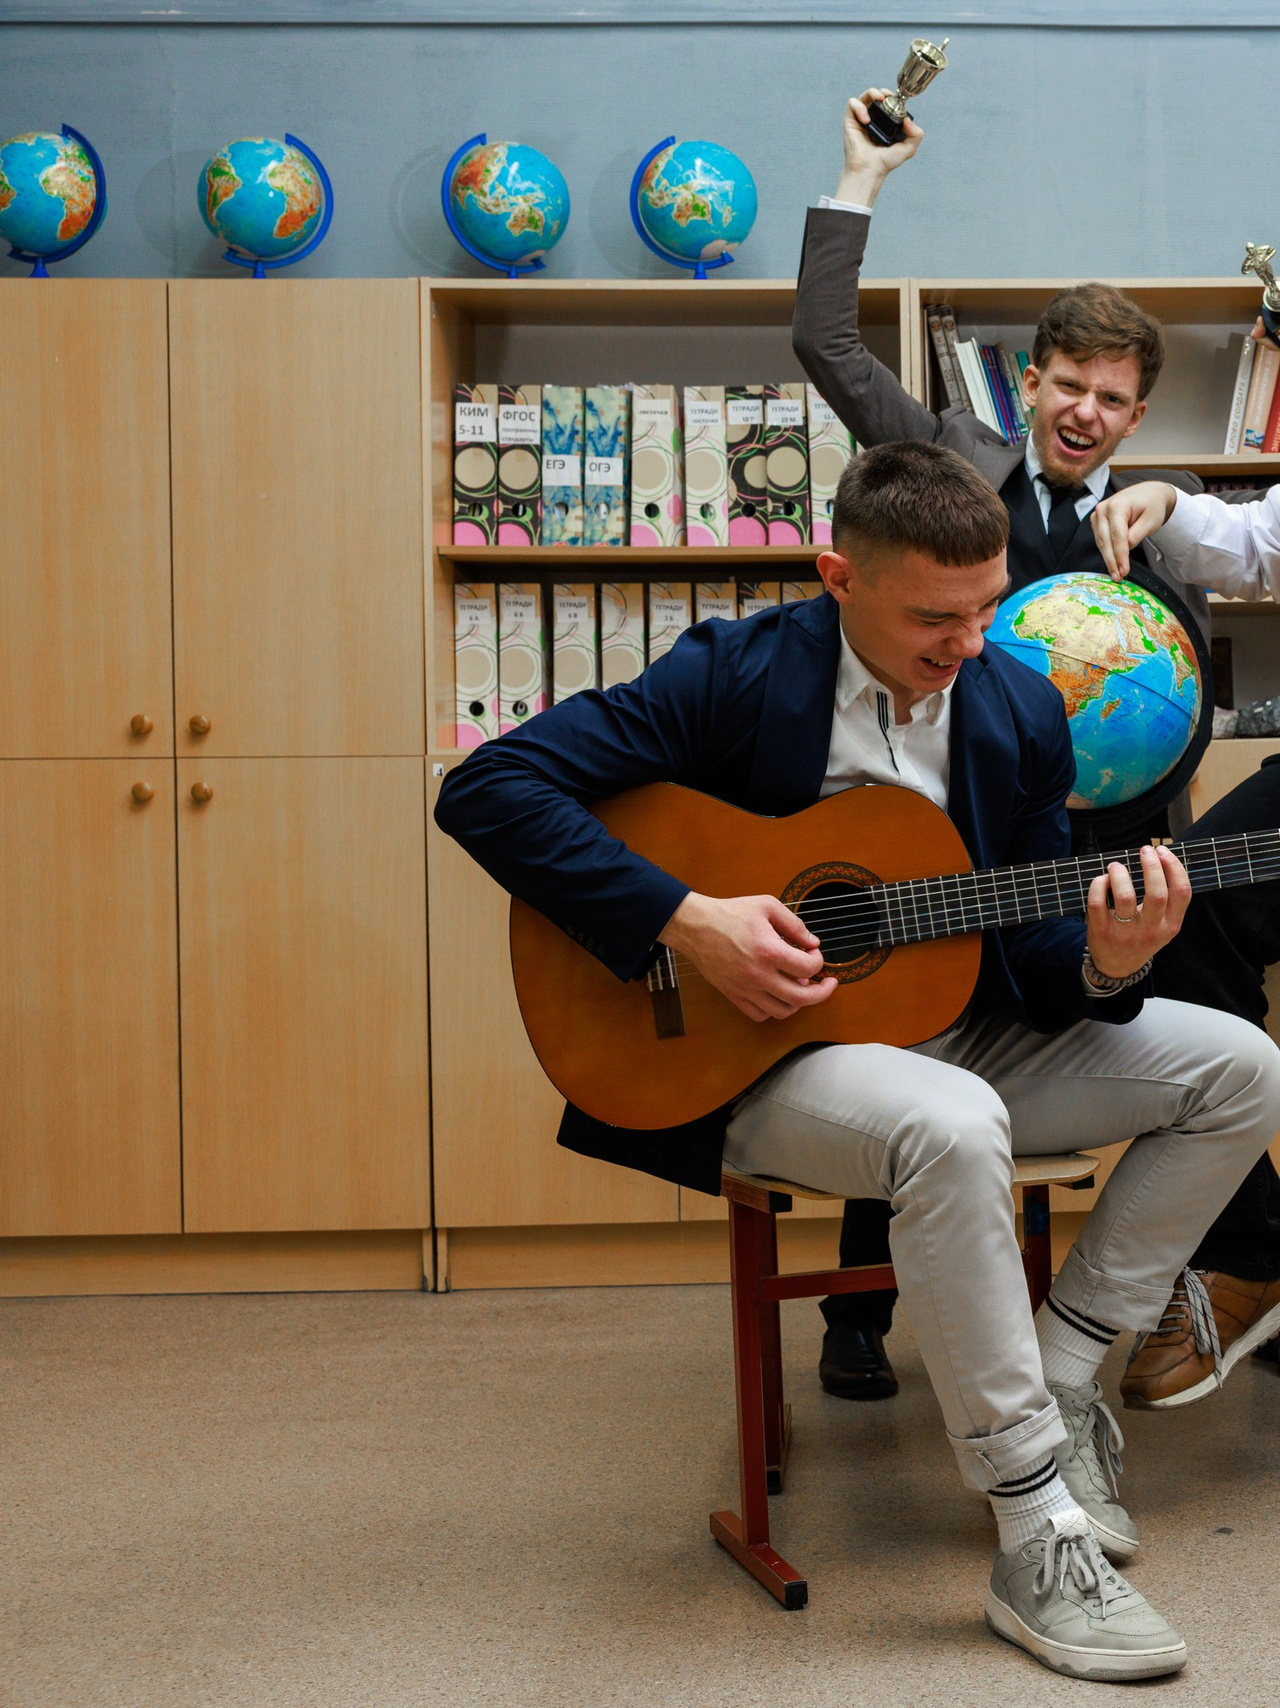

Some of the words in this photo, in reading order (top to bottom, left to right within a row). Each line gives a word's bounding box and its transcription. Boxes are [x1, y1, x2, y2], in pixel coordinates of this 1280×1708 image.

[459, 406, 489, 418] КИМ
[732, 405, 760, 413] ТЕТРАДИ
[502, 410, 536, 422] ФГОС
[458, 424, 485, 436] 5-11
[546, 459, 566, 470] ЕГЭ
[589, 462, 611, 473] ОГЭ
